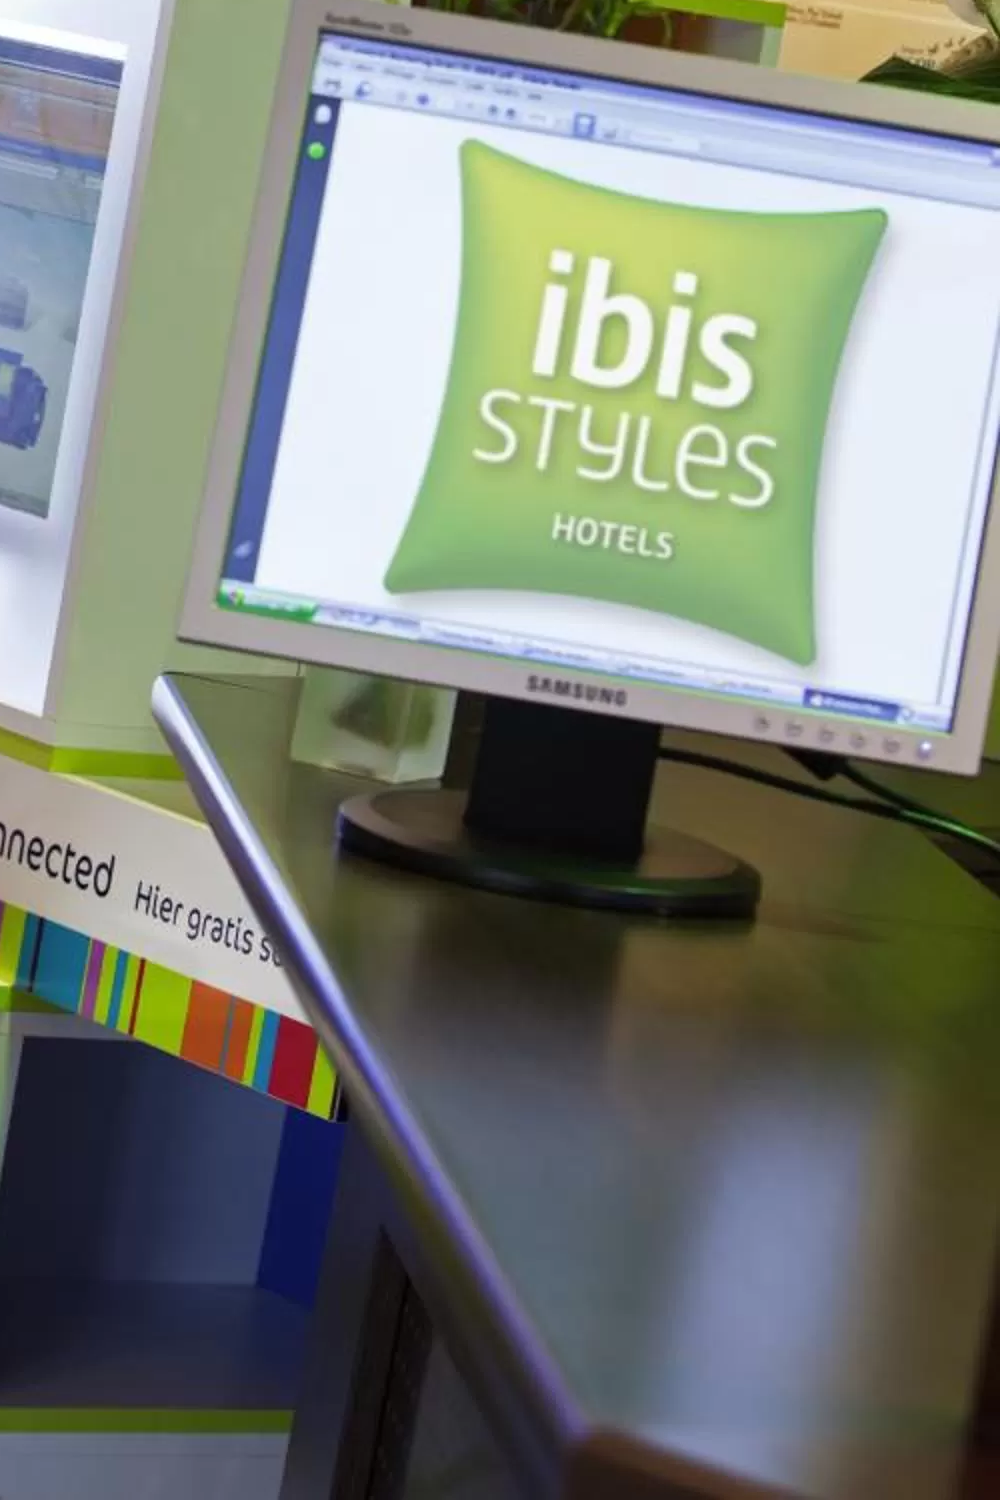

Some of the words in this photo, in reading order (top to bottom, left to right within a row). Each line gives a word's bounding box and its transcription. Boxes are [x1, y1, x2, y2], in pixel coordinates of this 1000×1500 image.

[532, 249, 758, 409] ibis
[551, 513, 675, 560] HOTELS
[526, 674, 628, 707] SAMSUNG
[134, 879, 182, 926] Hier
[187, 903, 255, 956] gratis
